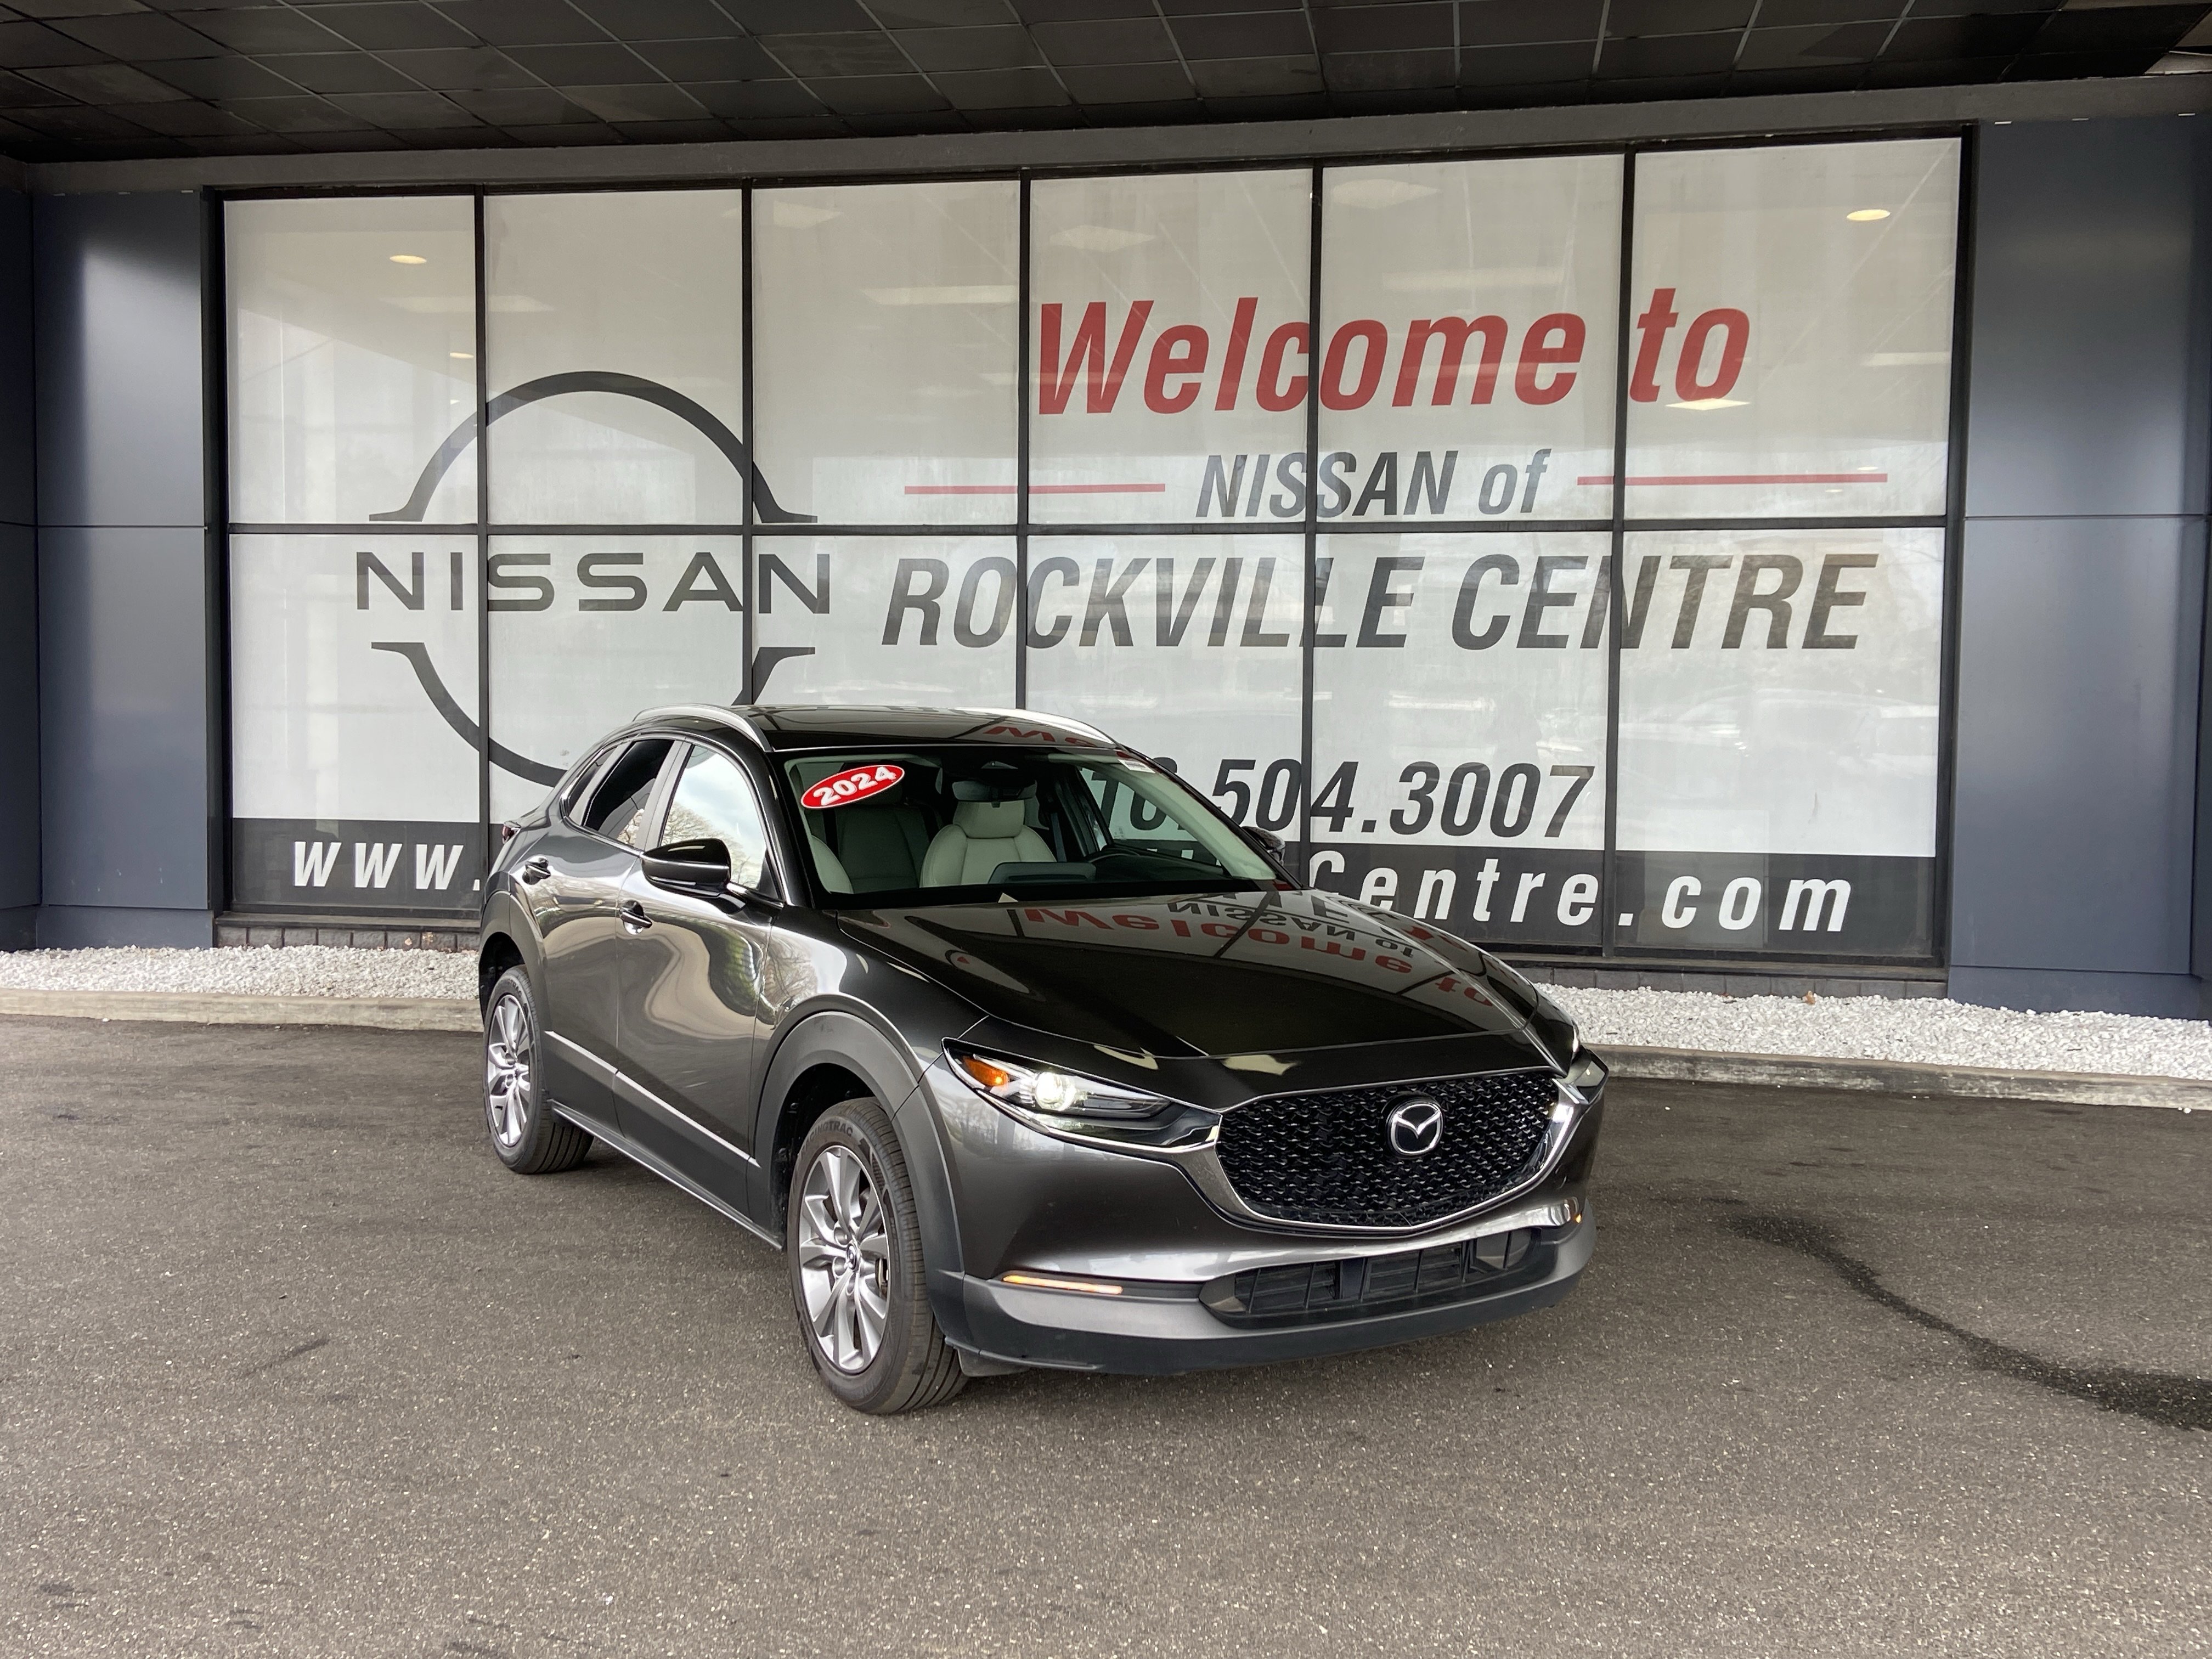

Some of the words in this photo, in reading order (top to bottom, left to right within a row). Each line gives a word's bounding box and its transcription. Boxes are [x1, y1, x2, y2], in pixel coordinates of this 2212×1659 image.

[1039, 297, 1586, 415] Welcome
[1629, 287, 1750, 403] to
[1195, 450, 1458, 518] NISSAN
[1478, 449, 1552, 514] of
[356, 551, 830, 614] NISSAN
[882, 556, 1425, 649] ROCKVILLE
[1451, 554, 1879, 651] CENTRE
[812, 766, 897, 806] 2024
